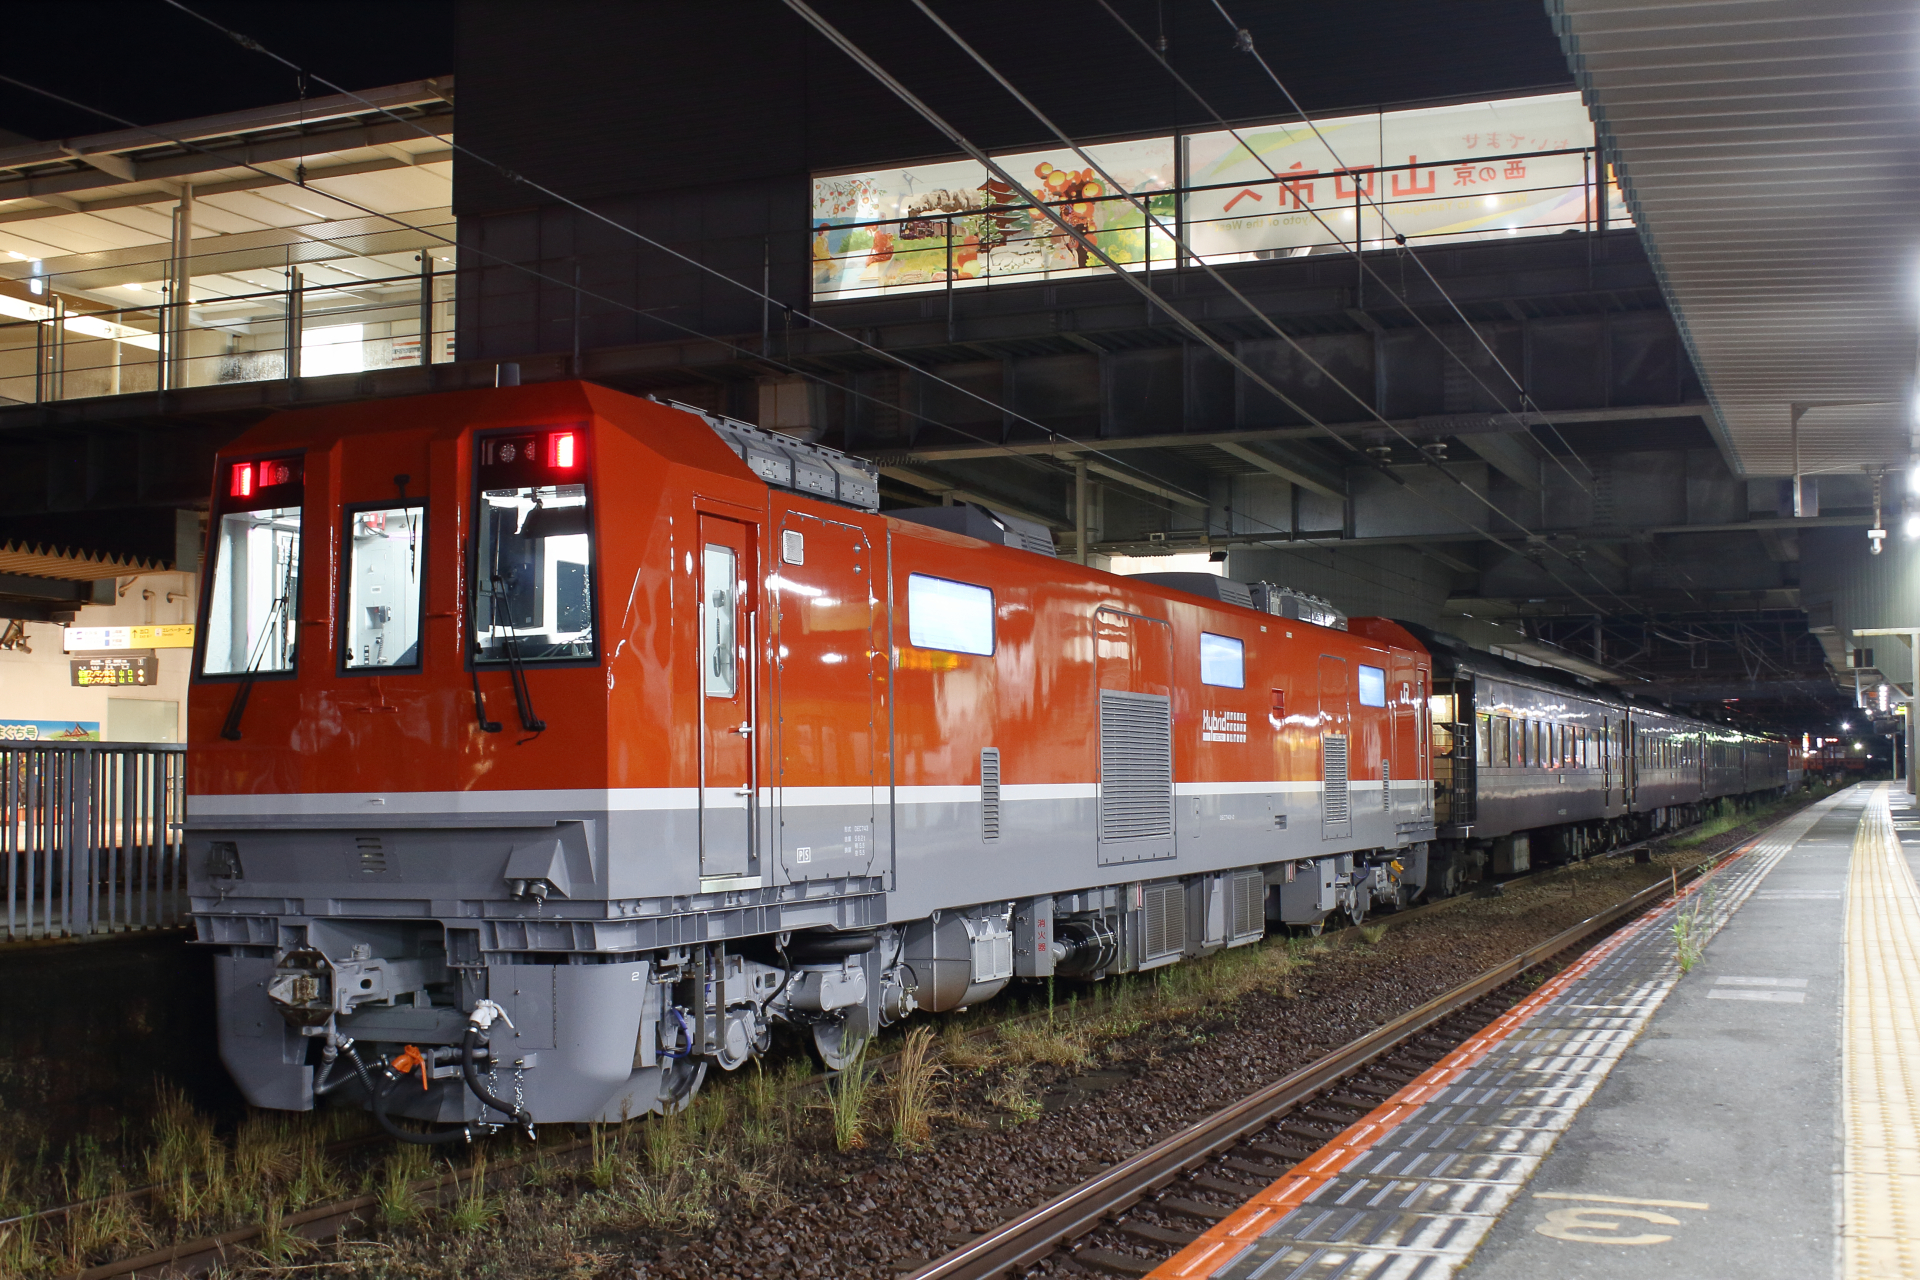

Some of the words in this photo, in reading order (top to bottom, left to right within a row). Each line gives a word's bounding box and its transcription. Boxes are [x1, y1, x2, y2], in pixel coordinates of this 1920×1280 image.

[1400, 682, 1410, 705] JR
[1202, 709, 1227, 741] Hybrid
[1037, 918, 1046, 952] 消火器
[631, 971, 640, 982] 2
